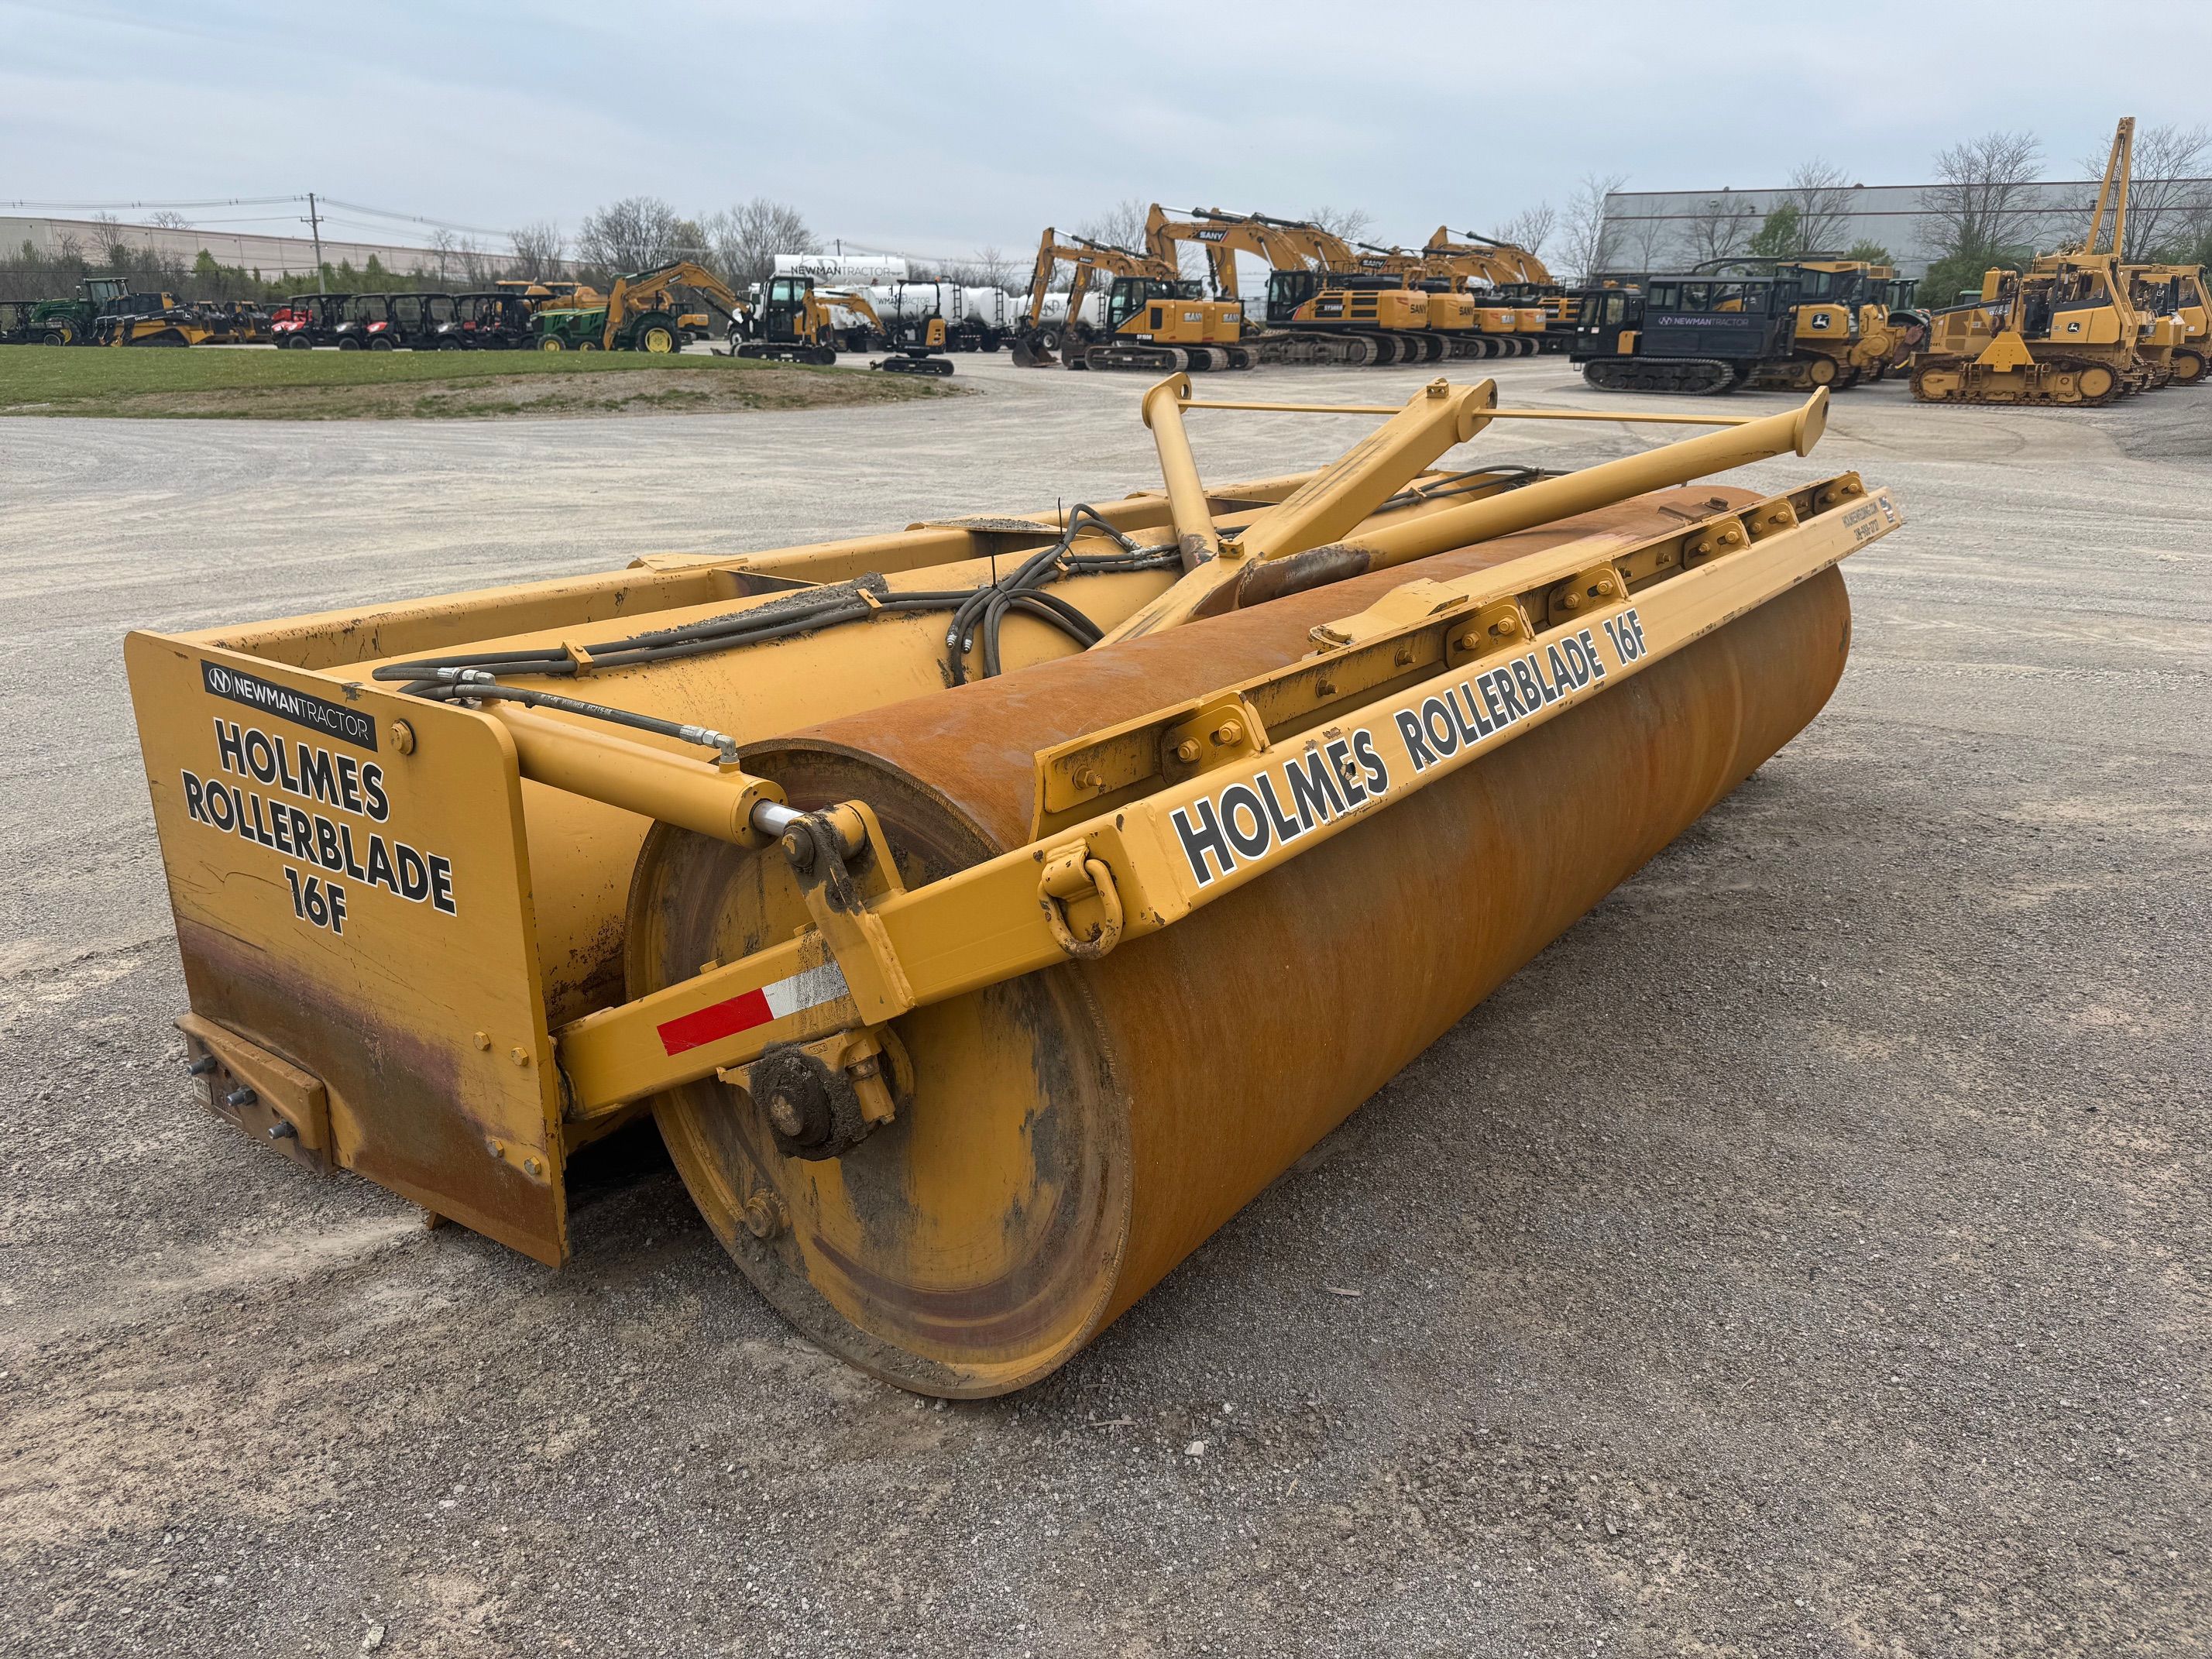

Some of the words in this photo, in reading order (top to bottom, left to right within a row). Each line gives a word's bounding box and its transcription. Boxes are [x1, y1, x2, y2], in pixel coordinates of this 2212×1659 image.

[1200, 231, 1224, 240] SANY
[791, 266, 891, 277] NEWMANTRACTOR
[1673, 317, 1750, 326] NEWMANTRACTOR
[234, 675, 369, 740] NEWMANTRACTOR
[213, 716, 390, 824] HOLMES
[1169, 728, 1389, 889] HOLMES
[1393, 628, 1606, 775] ROLLERBLADE
[1602, 608, 1648, 668] 16F
[180, 768, 458, 918] ROLLERBLADE
[283, 864, 348, 936] 16F
